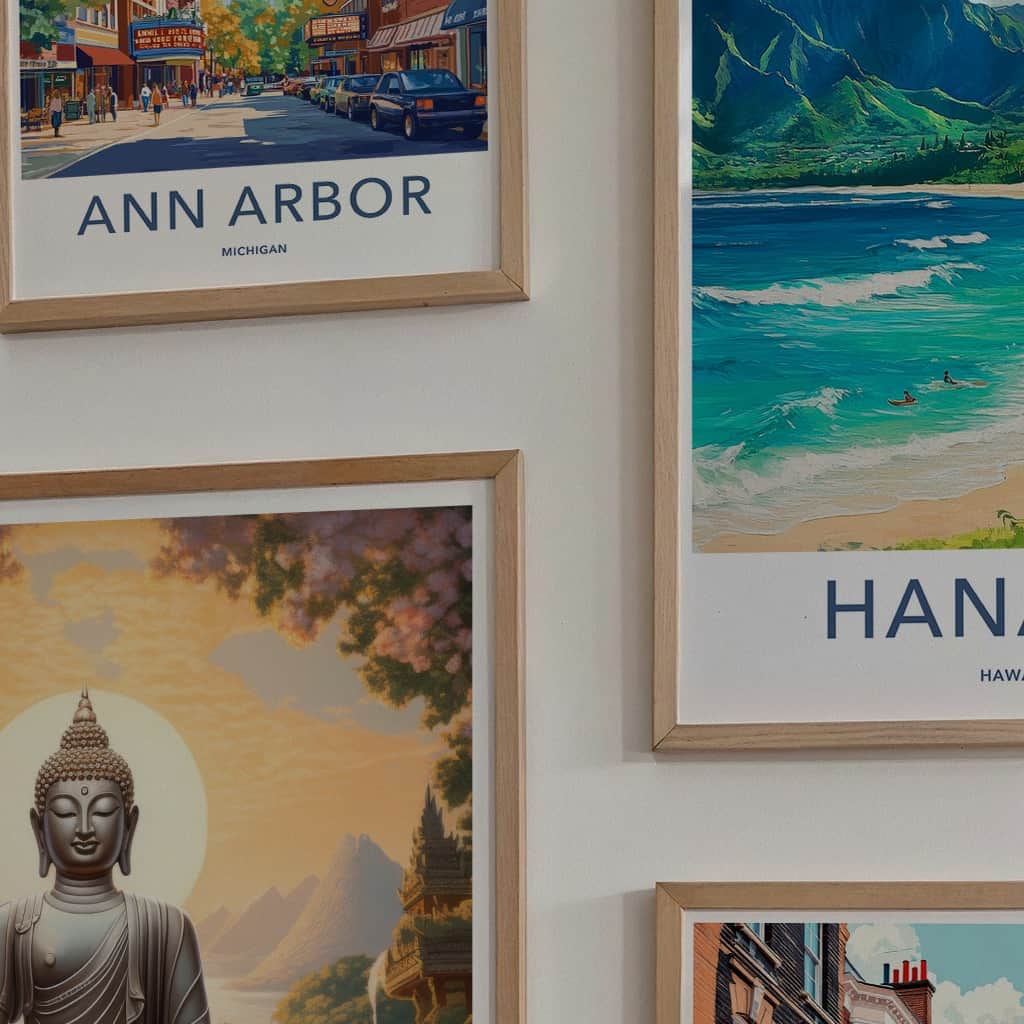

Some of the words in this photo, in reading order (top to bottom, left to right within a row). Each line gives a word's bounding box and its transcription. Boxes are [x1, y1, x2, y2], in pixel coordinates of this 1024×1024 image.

[77, 188, 204, 236] ANN
[229, 175, 432, 227] ARBOR
[222, 244, 287, 257] MICHIGAN
[827, 577, 1024, 639] HAN
